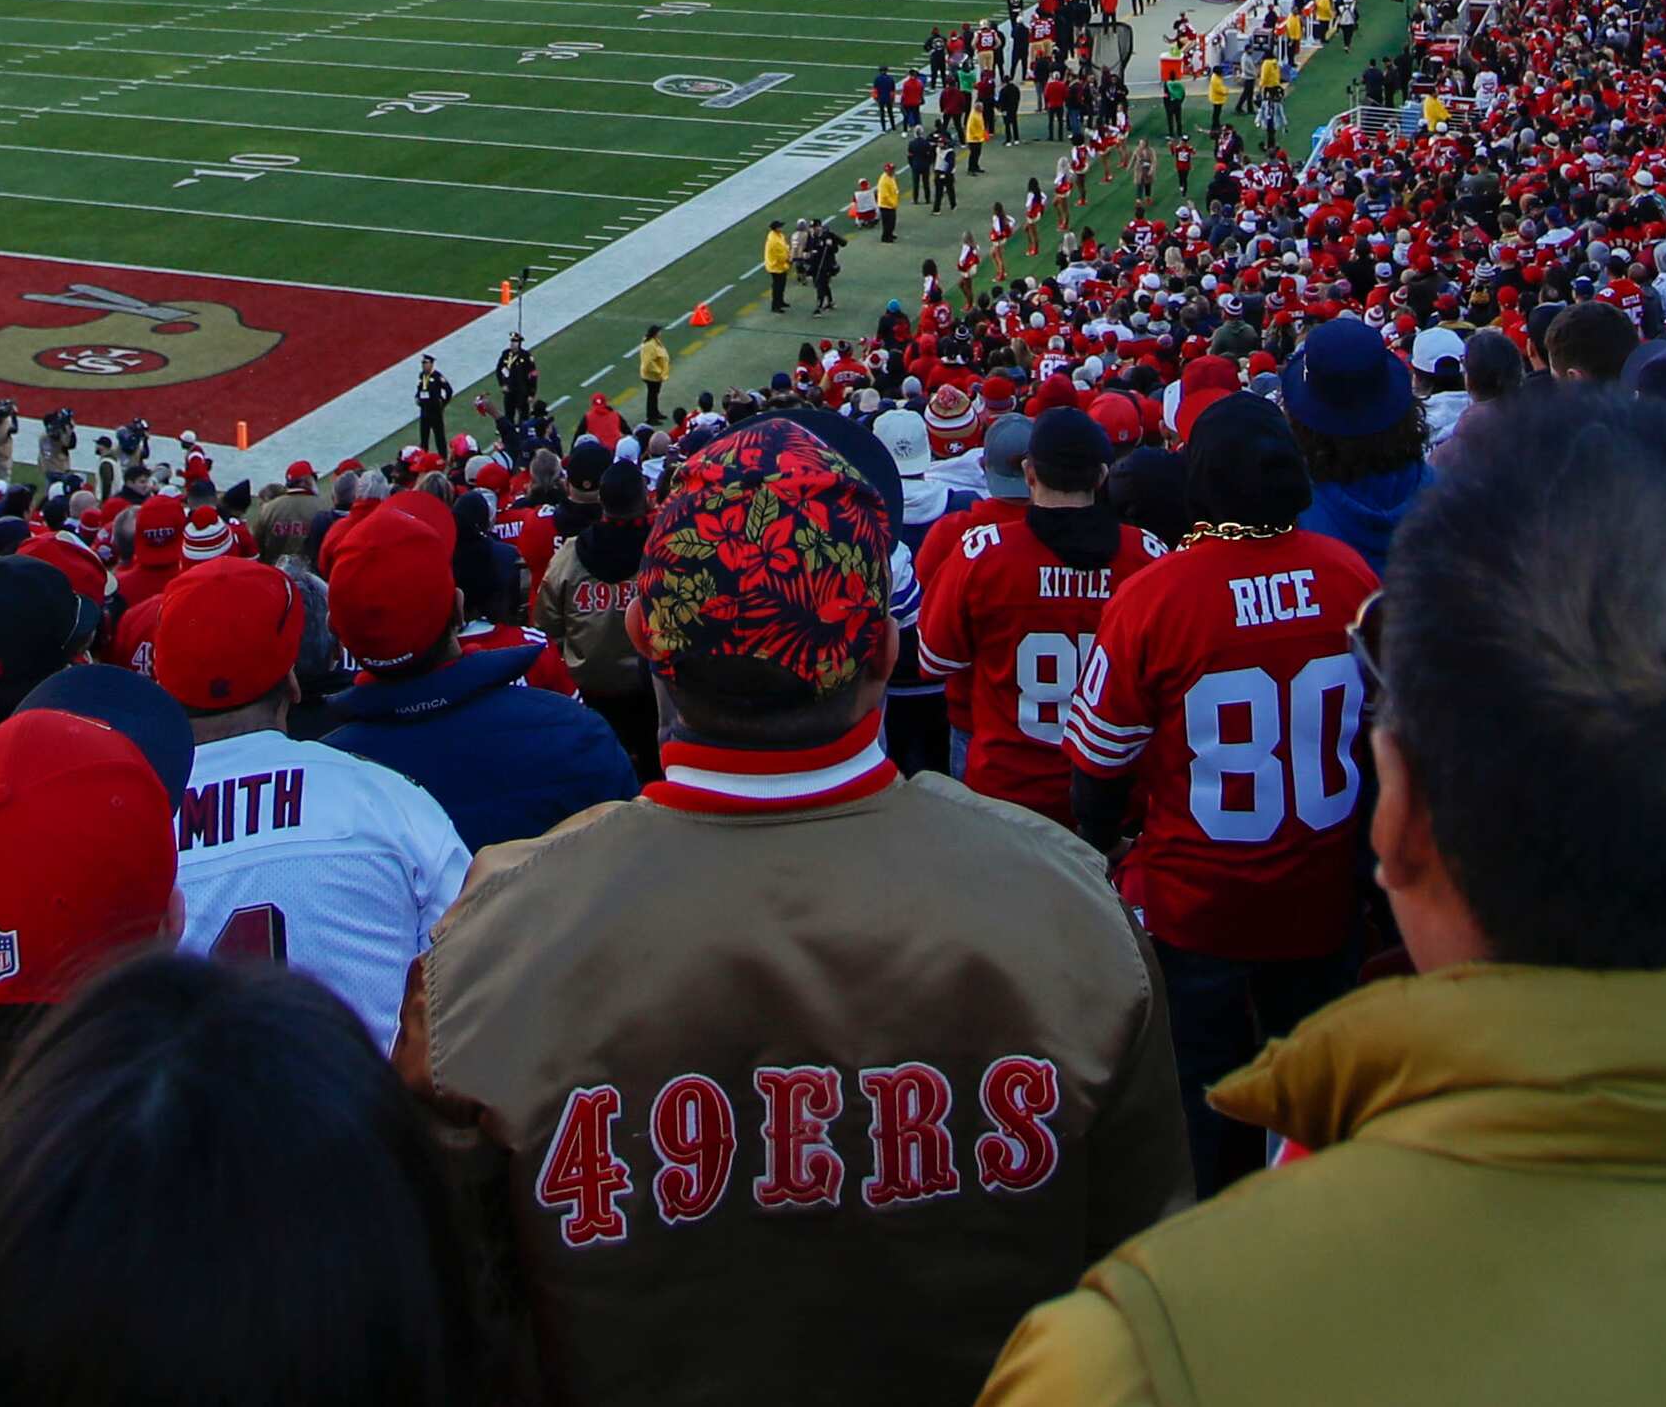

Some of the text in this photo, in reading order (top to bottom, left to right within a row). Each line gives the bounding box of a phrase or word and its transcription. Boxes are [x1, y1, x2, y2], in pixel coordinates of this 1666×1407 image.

[377, 91, 471, 114] 20
[192, 154, 301, 182] 10
[1039, 566, 1111, 599] KITTLE
[1229, 569, 1322, 629] RICE
[396, 696, 448, 715] NAUTICA
[1183, 652, 1366, 844] 80
[178, 767, 306, 853] MITH
[537, 1054, 1061, 1249] 49ERS
